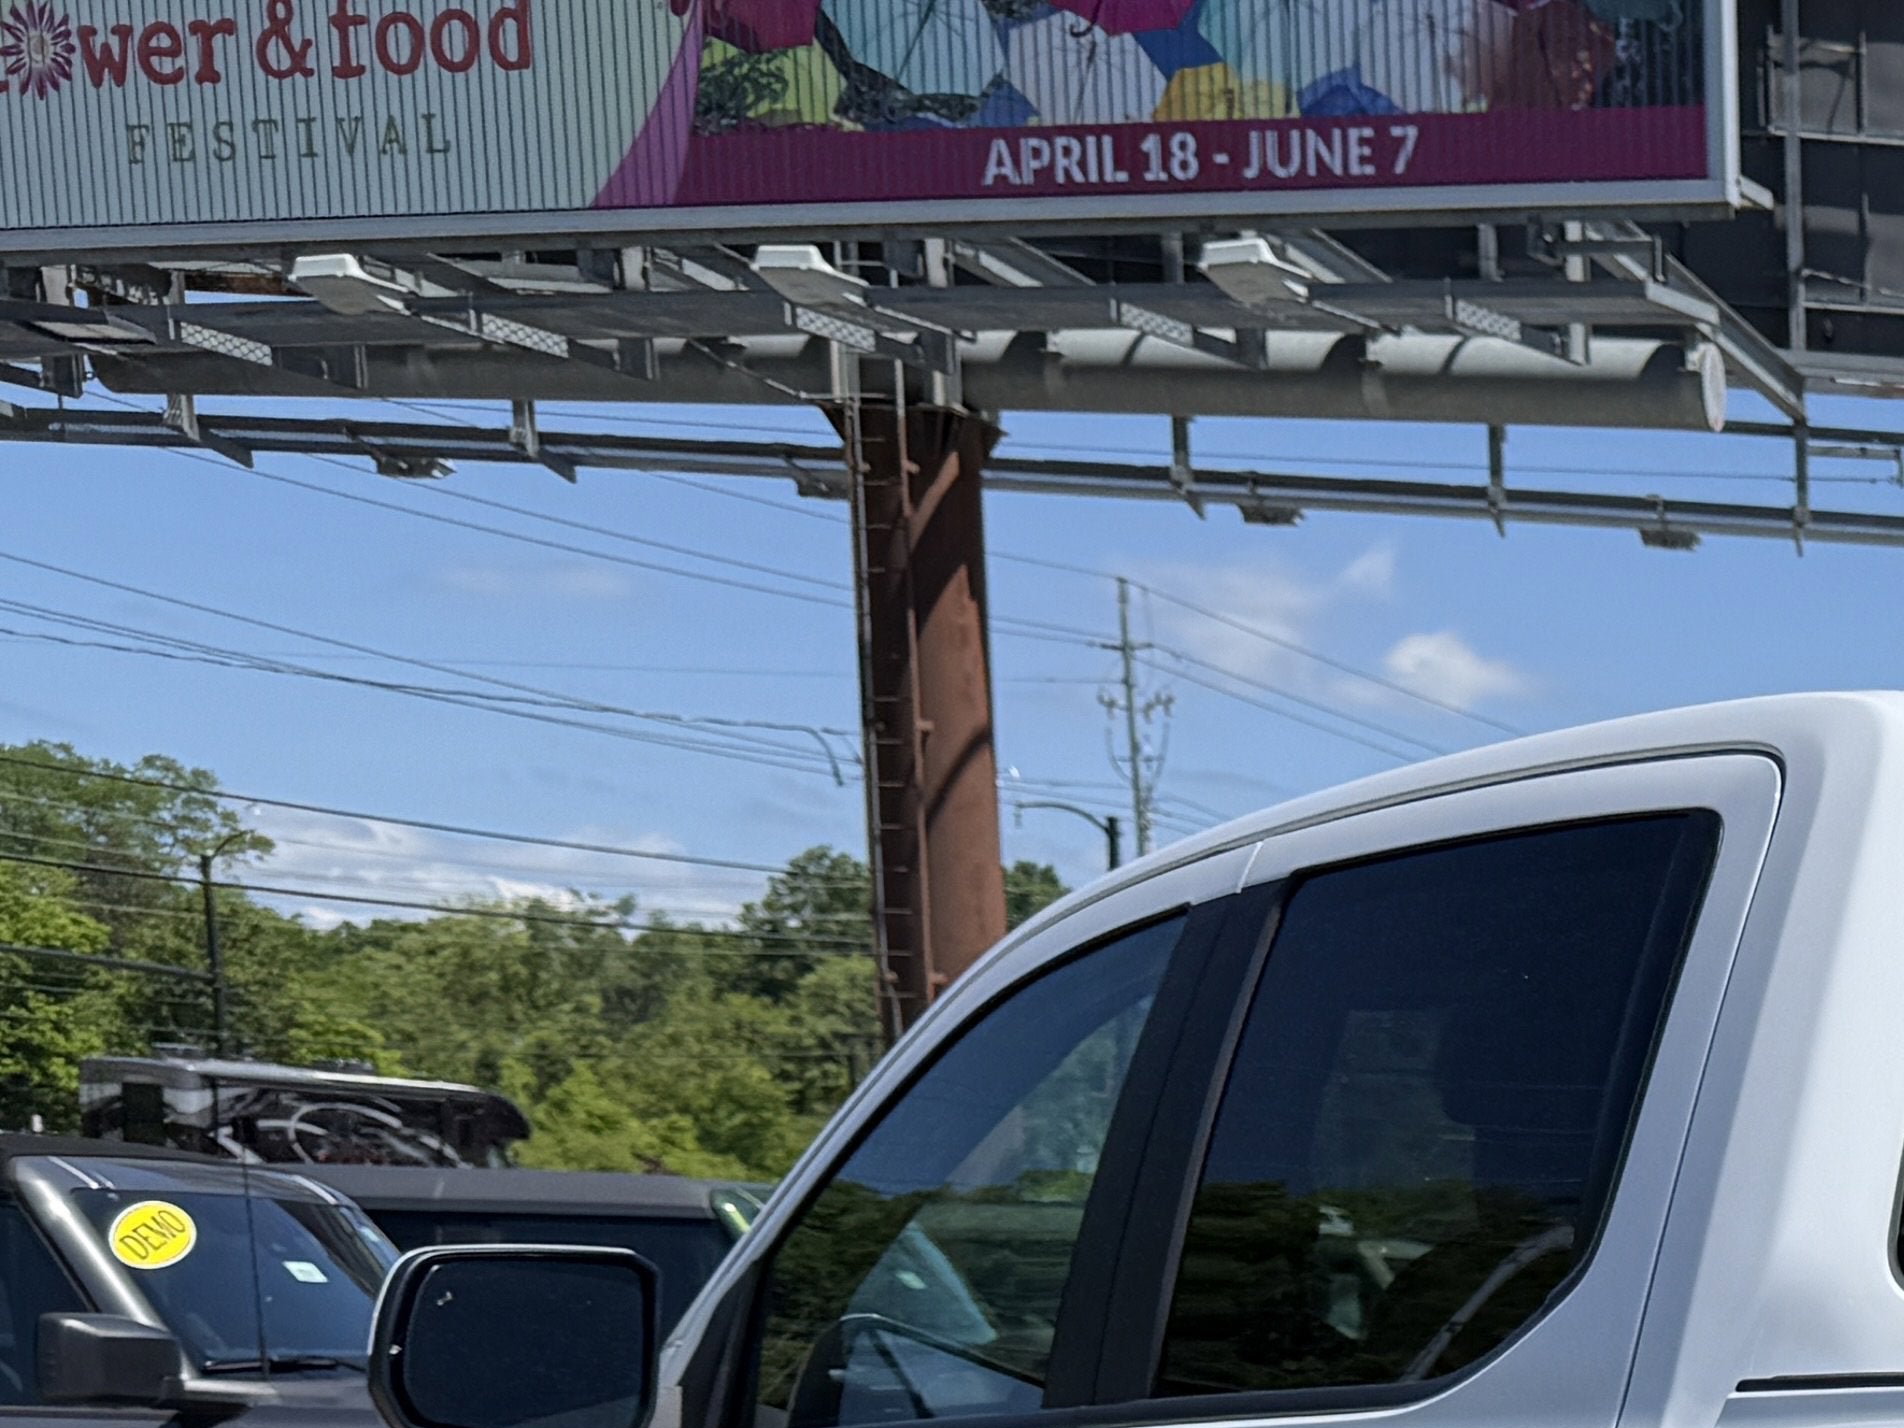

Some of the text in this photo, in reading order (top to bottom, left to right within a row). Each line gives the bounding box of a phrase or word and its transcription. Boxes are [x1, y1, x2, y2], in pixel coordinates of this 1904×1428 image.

[255, 0, 314, 80] &
[126, 112, 451, 165] FESTIVAL
[983, 125, 1418, 186] APRIL 18 - JUNE 7
[119, 1210, 186, 1260] DEMO
